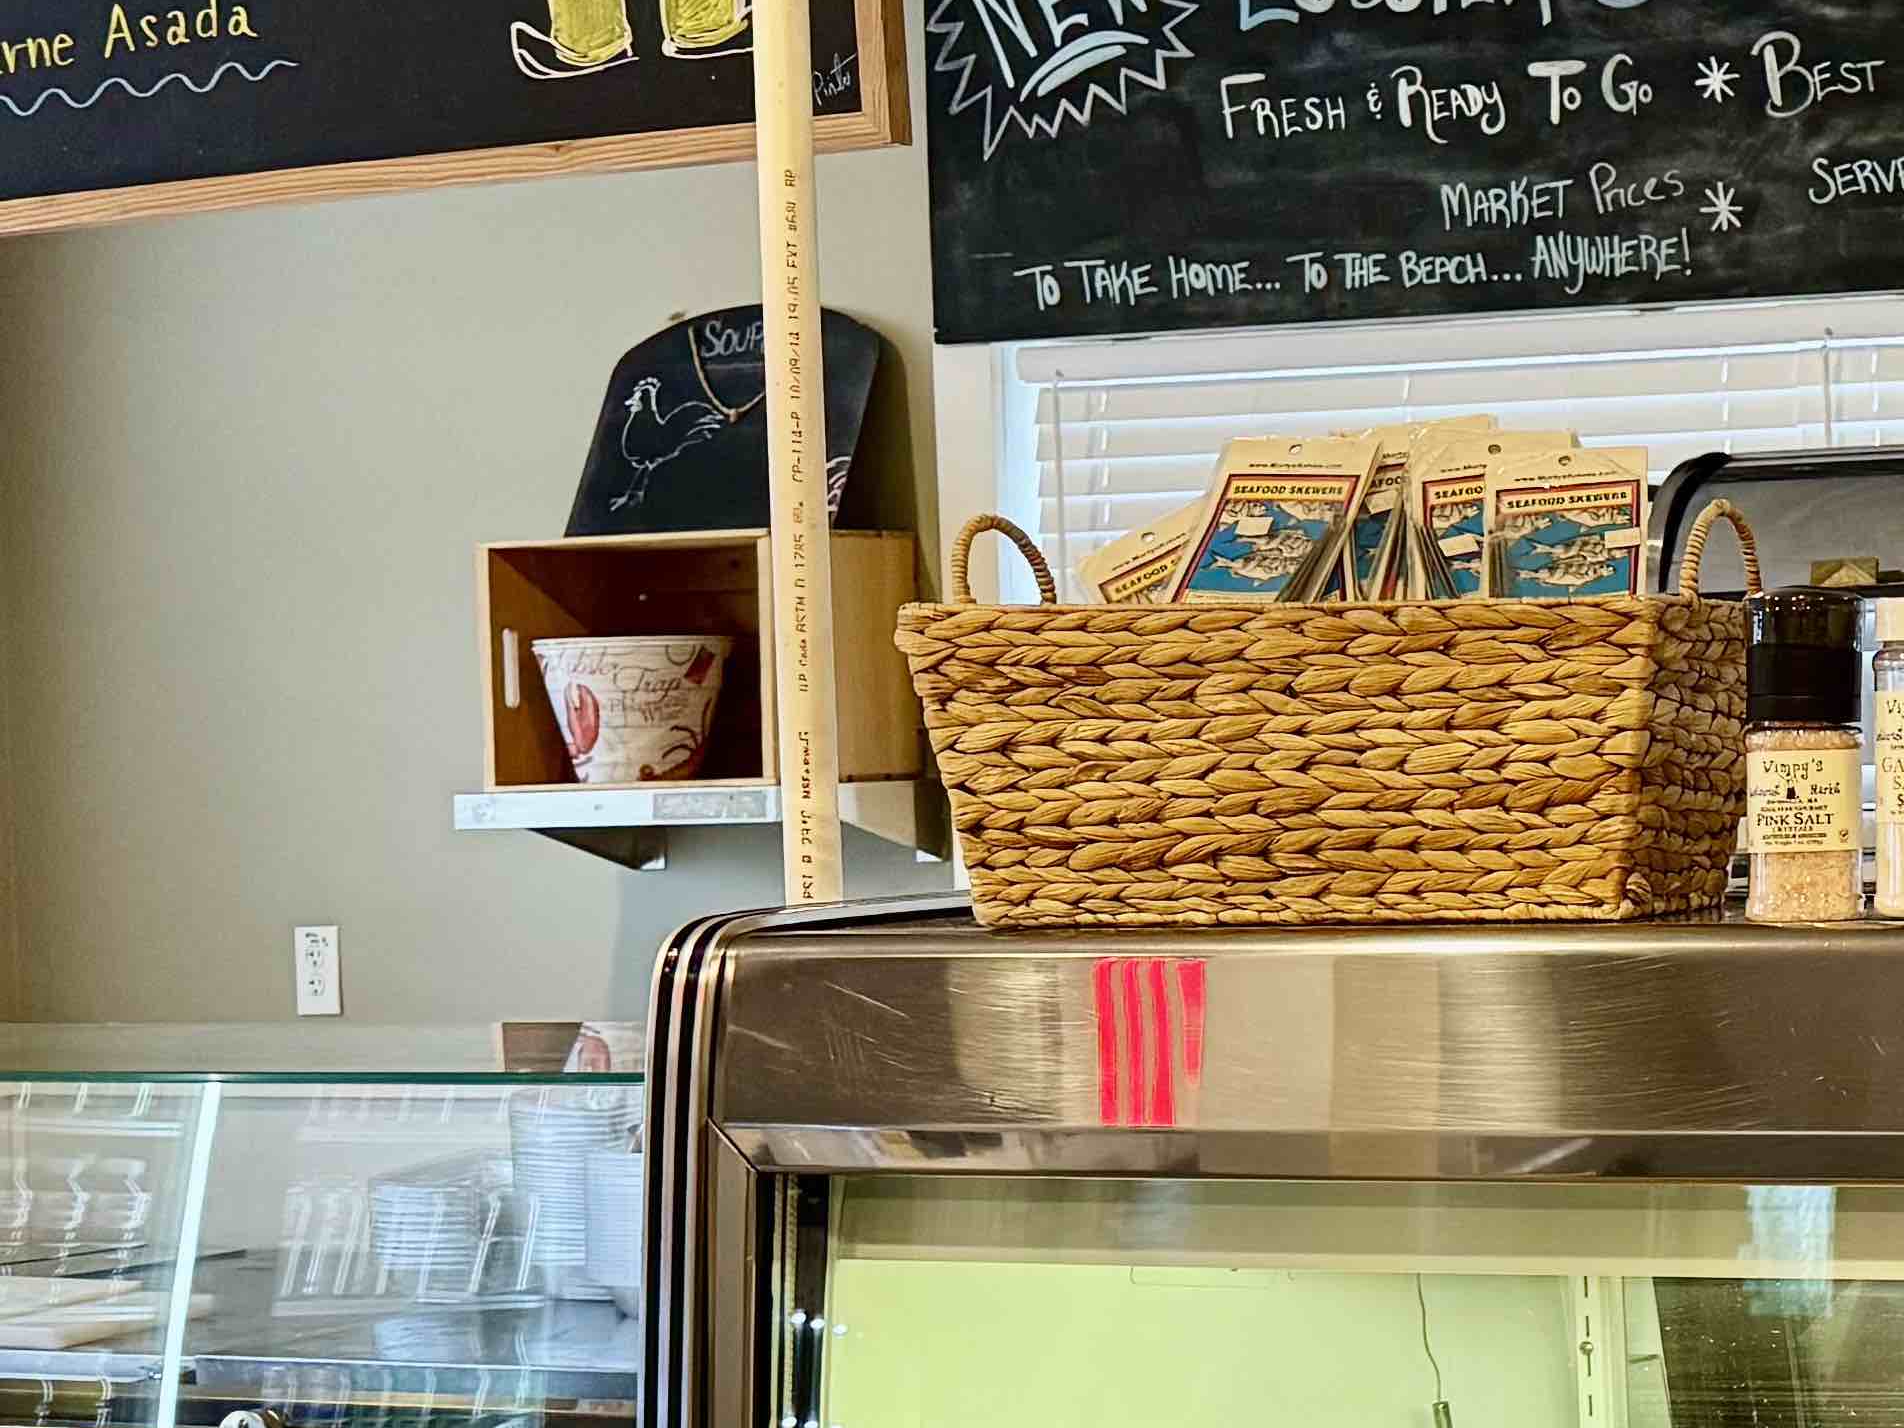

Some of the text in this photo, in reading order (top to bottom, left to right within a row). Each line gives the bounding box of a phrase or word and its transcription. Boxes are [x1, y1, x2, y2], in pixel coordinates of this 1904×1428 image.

[0, 32, 75, 74] rne
[1751, 31, 1885, 118] BEST
[1220, 73, 1347, 142] FRESH
[1441, 178, 1574, 233] MARKET
[1066, 258, 1159, 306] TAKE
[1333, 251, 1390, 289] THE
[1434, 484, 1486, 500] SEAFOO
[1794, 812, 1834, 825] SALT
